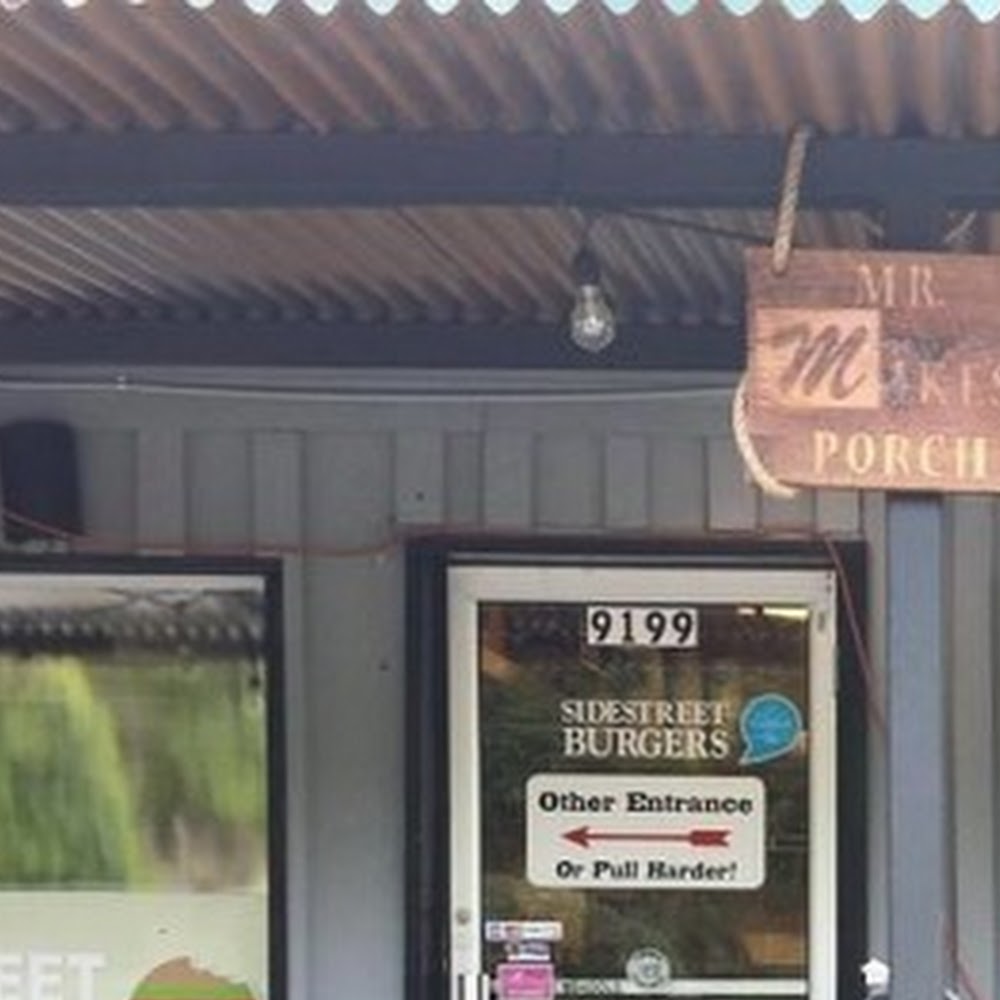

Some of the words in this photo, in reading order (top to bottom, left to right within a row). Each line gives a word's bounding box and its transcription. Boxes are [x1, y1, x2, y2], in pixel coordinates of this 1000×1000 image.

[812, 431, 988, 479] PORCH
[591, 610, 693, 643] 9199
[561, 700, 728, 725] SIDESTREET
[563, 727, 730, 760] BURGERS
[538, 793, 615, 813] Other
[627, 793, 753, 815] Entrance
[556, 861, 584, 879] Or
[592, 861, 639, 880] Pull
[647, 861, 738, 881] Harder!
